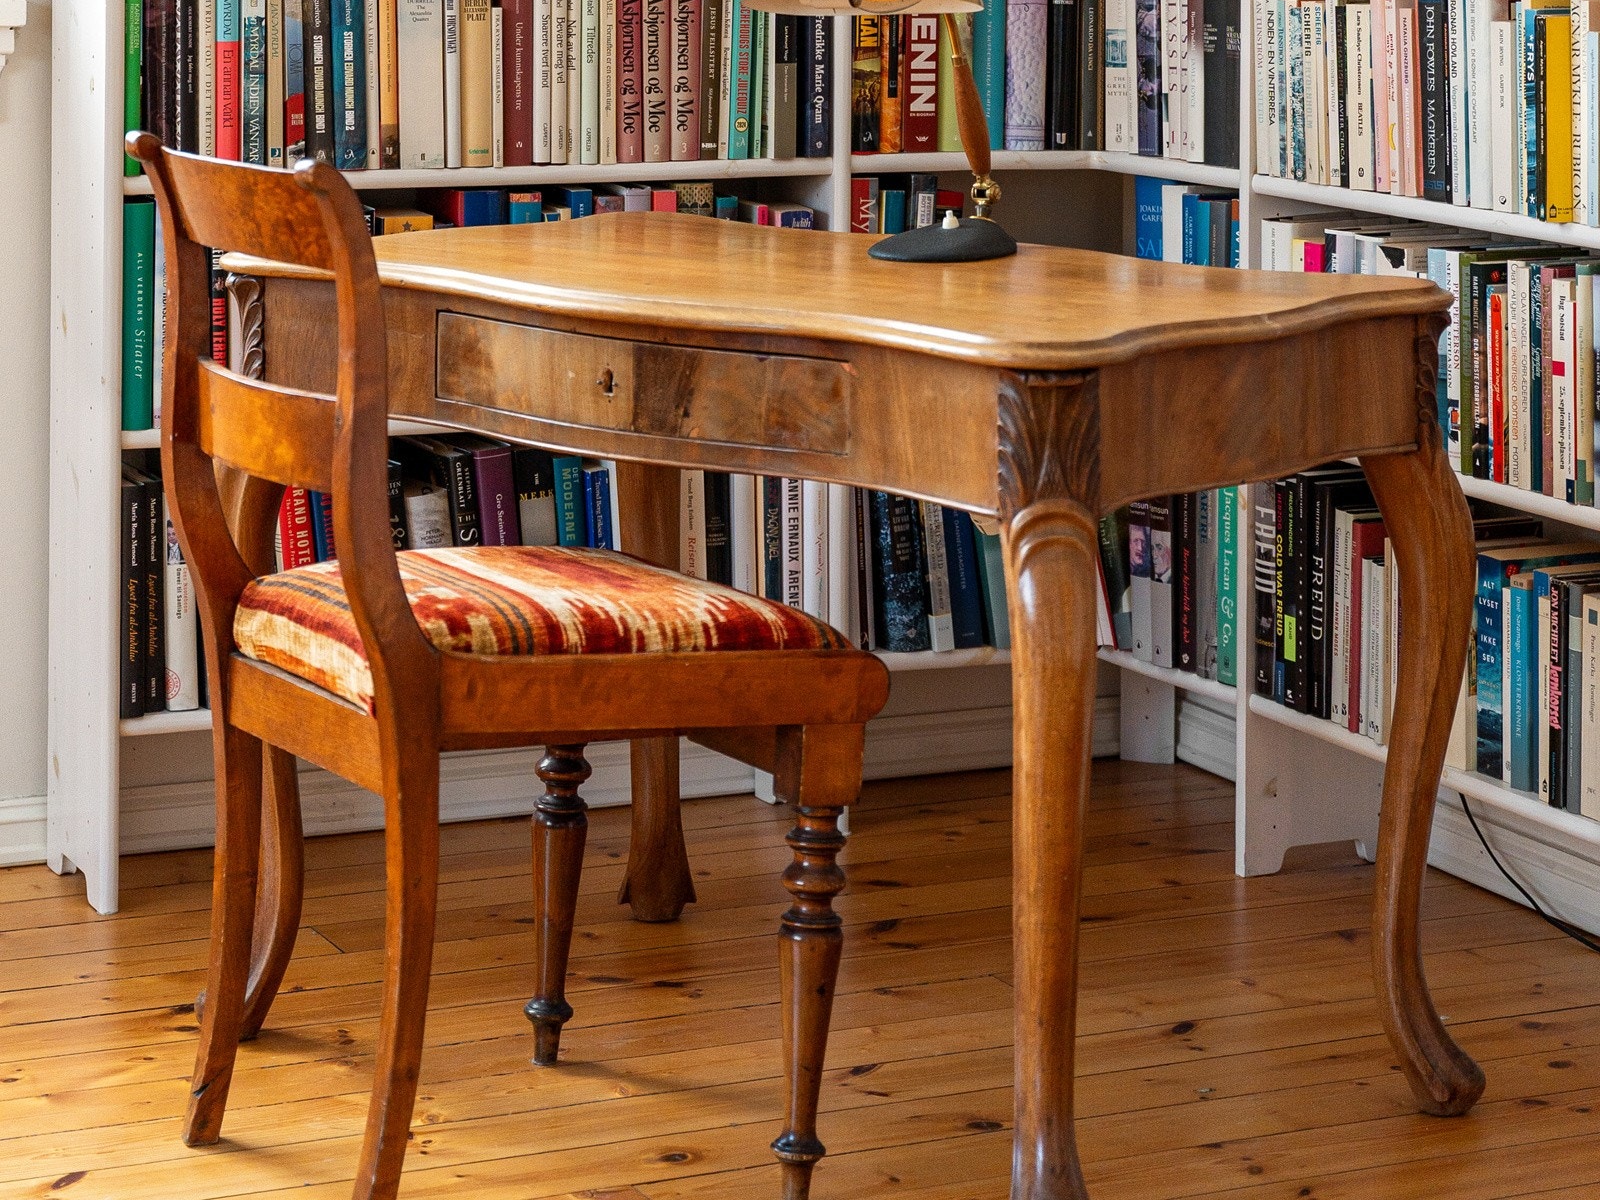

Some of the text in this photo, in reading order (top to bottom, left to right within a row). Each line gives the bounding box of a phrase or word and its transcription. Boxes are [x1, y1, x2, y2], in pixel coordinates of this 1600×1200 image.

[464, 0, 488, 7] BERLIN
[466, 13, 487, 21] PLATZ
[271, 3, 280, 60] JAN MYRDAL
[344, 31, 354, 61] STORMEN
[515, 22, 523, 46] Under
[586, 26, 596, 63] Tiltredes
[1304, 6, 1312, 57] SCHERFIG
[1354, 27, 1362, 53] Saabye
[1450, 0, 1459, 78] RAGNAR HOVLAND
[313, 35, 324, 64] STORMEN
[554, 17, 566, 84] Bevare meg vel
[910, 13, 938, 113] ENIN
[1526, 42, 1535, 80] FRYS
[314, 66, 325, 90] EDVARD
[344, 62, 354, 86] EDVARD
[514, 48, 523, 98] kunnskapens
[811, 15, 825, 124] Fredrikke Marie Qvam
[345, 86, 355, 109] MUNCH
[619, 78, 635, 96] og
[645, 77, 661, 94] og
[674, 76, 691, 93] og
[1425, 5, 1437, 175] JOHN FOWLES MAGIKEREN
[1450, 85, 1459, 110] Vegen
[314, 90, 325, 113] MUNCH
[648, 99, 666, 132] Moe
[676, 98, 694, 132] Moe
[1571, 1, 1581, 210] AGNAR MYKLE RUBICON
[315, 114, 325, 129] BIND
[346, 110, 355, 125] BIND
[623, 100, 641, 134] Moe
[653, 144, 660, 154] 2
[681, 141, 688, 152] 3
[1450, 132, 1458, 143] og
[1451, 144, 1460, 172] porten
[212, 298, 226, 327] HOLY
[1558, 295, 1566, 310] Dag
[1558, 313, 1566, 341] Solstad
[134, 329, 146, 380] Sitater
[1558, 399, 1567, 470] september-plassen
[455, 462, 466, 508] GREENBLATT
[788, 479, 799, 513] ANNIE
[562, 467, 577, 541] MODERNE
[595, 501, 603, 514] Berg
[687, 537, 697, 568] Reisen
[788, 517, 799, 562] ERNAUX
[1255, 505, 1276, 595] FREUD
[1221, 488, 1234, 648] Jacques Lacan & Co.
[1311, 555, 1324, 641] FREUD
[1483, 579, 1495, 590] ALT
[175, 594, 183, 620] Santiago
[1478, 596, 1499, 610] LYSET
[1276, 600, 1284, 637] FREUD
[1485, 617, 1492, 626] VI
[1480, 634, 1497, 646] IKKE
[1481, 653, 1495, 665] SER
[1549, 587, 1563, 730] JON MICHELET Jernkorset
